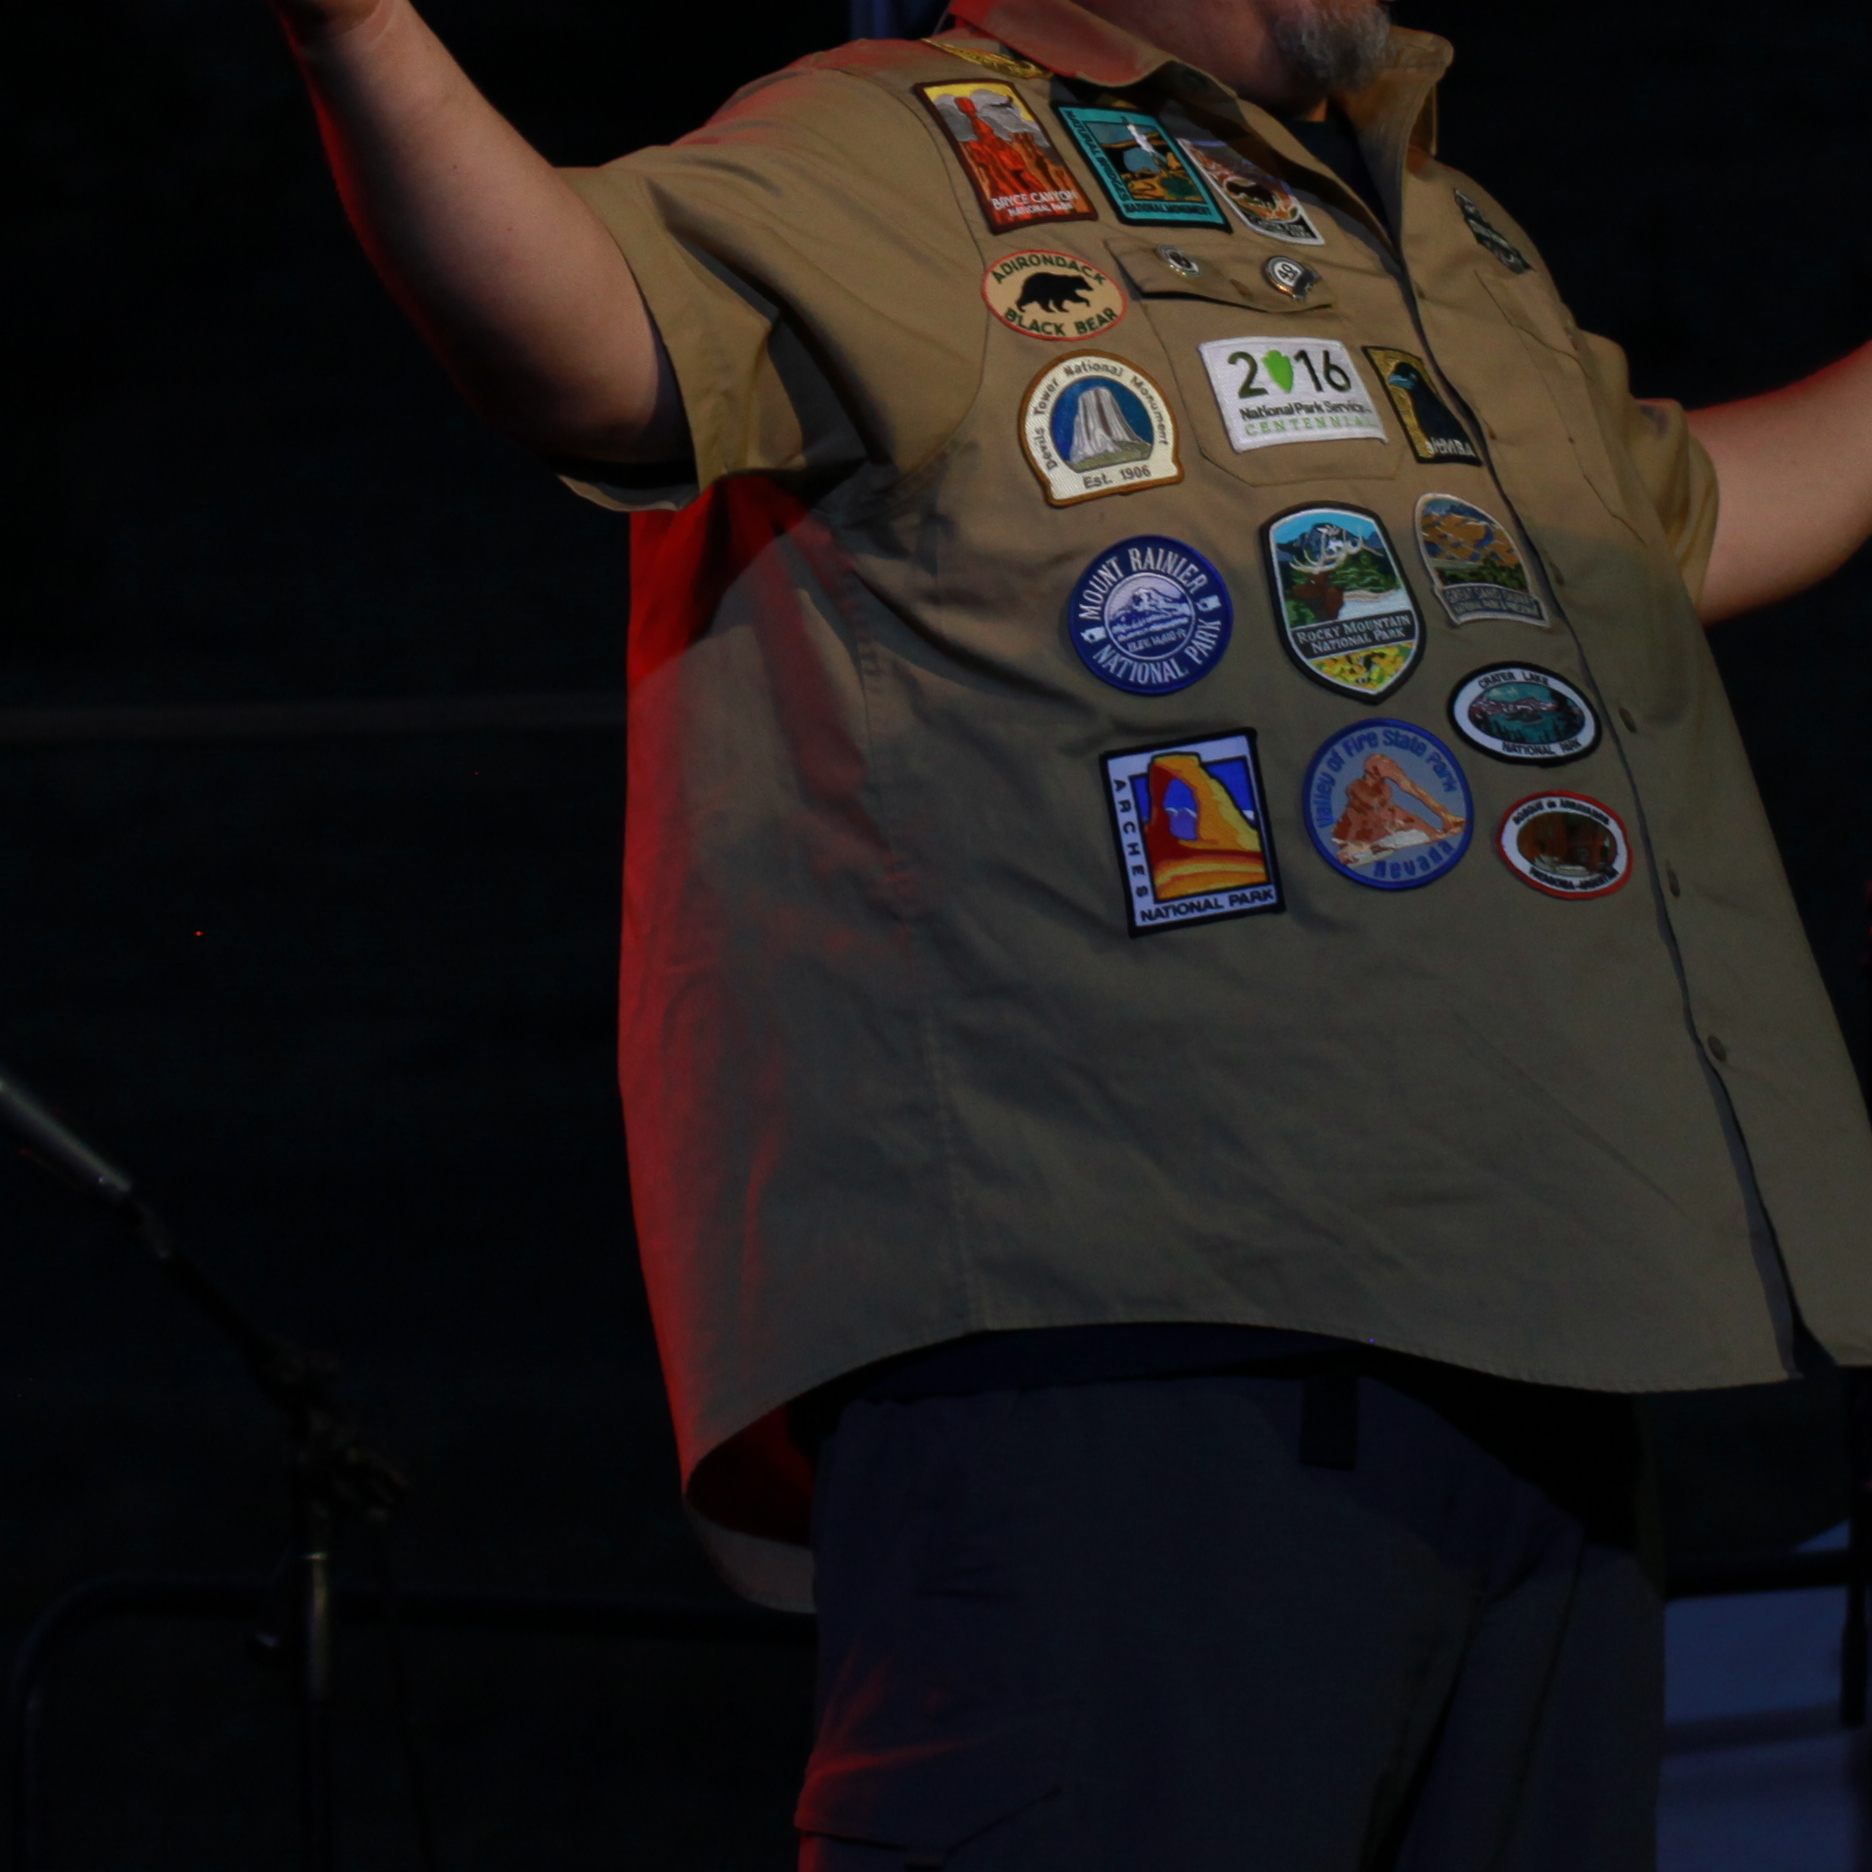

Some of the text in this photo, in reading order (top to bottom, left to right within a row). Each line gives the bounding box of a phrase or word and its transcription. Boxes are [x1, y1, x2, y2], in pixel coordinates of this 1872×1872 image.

[991, 192, 1029, 211] BRYCE
[991, 253, 1105, 285] ADIRONDACK
[1004, 306, 1118, 336] BLACK BEAR
[1032, 360, 1169, 471] Devils Tower National Monument
[1239, 402, 1294, 421] National
[1294, 400, 1324, 415] Park
[1083, 464, 1152, 489] Est. 1906
[1078, 546, 1209, 621] MOUNT RAINIER
[1296, 613, 1411, 645] ROCKY MOUNTAIN
[1311, 626, 1406, 655] NATIONAL PARK
[1091, 618, 1222, 686] NATIONAL PARK
[1478, 671, 1516, 689] CRATER
[1112, 779, 1149, 898] ARCHES
[1140, 888, 1274, 922] NATIONAL PARK
